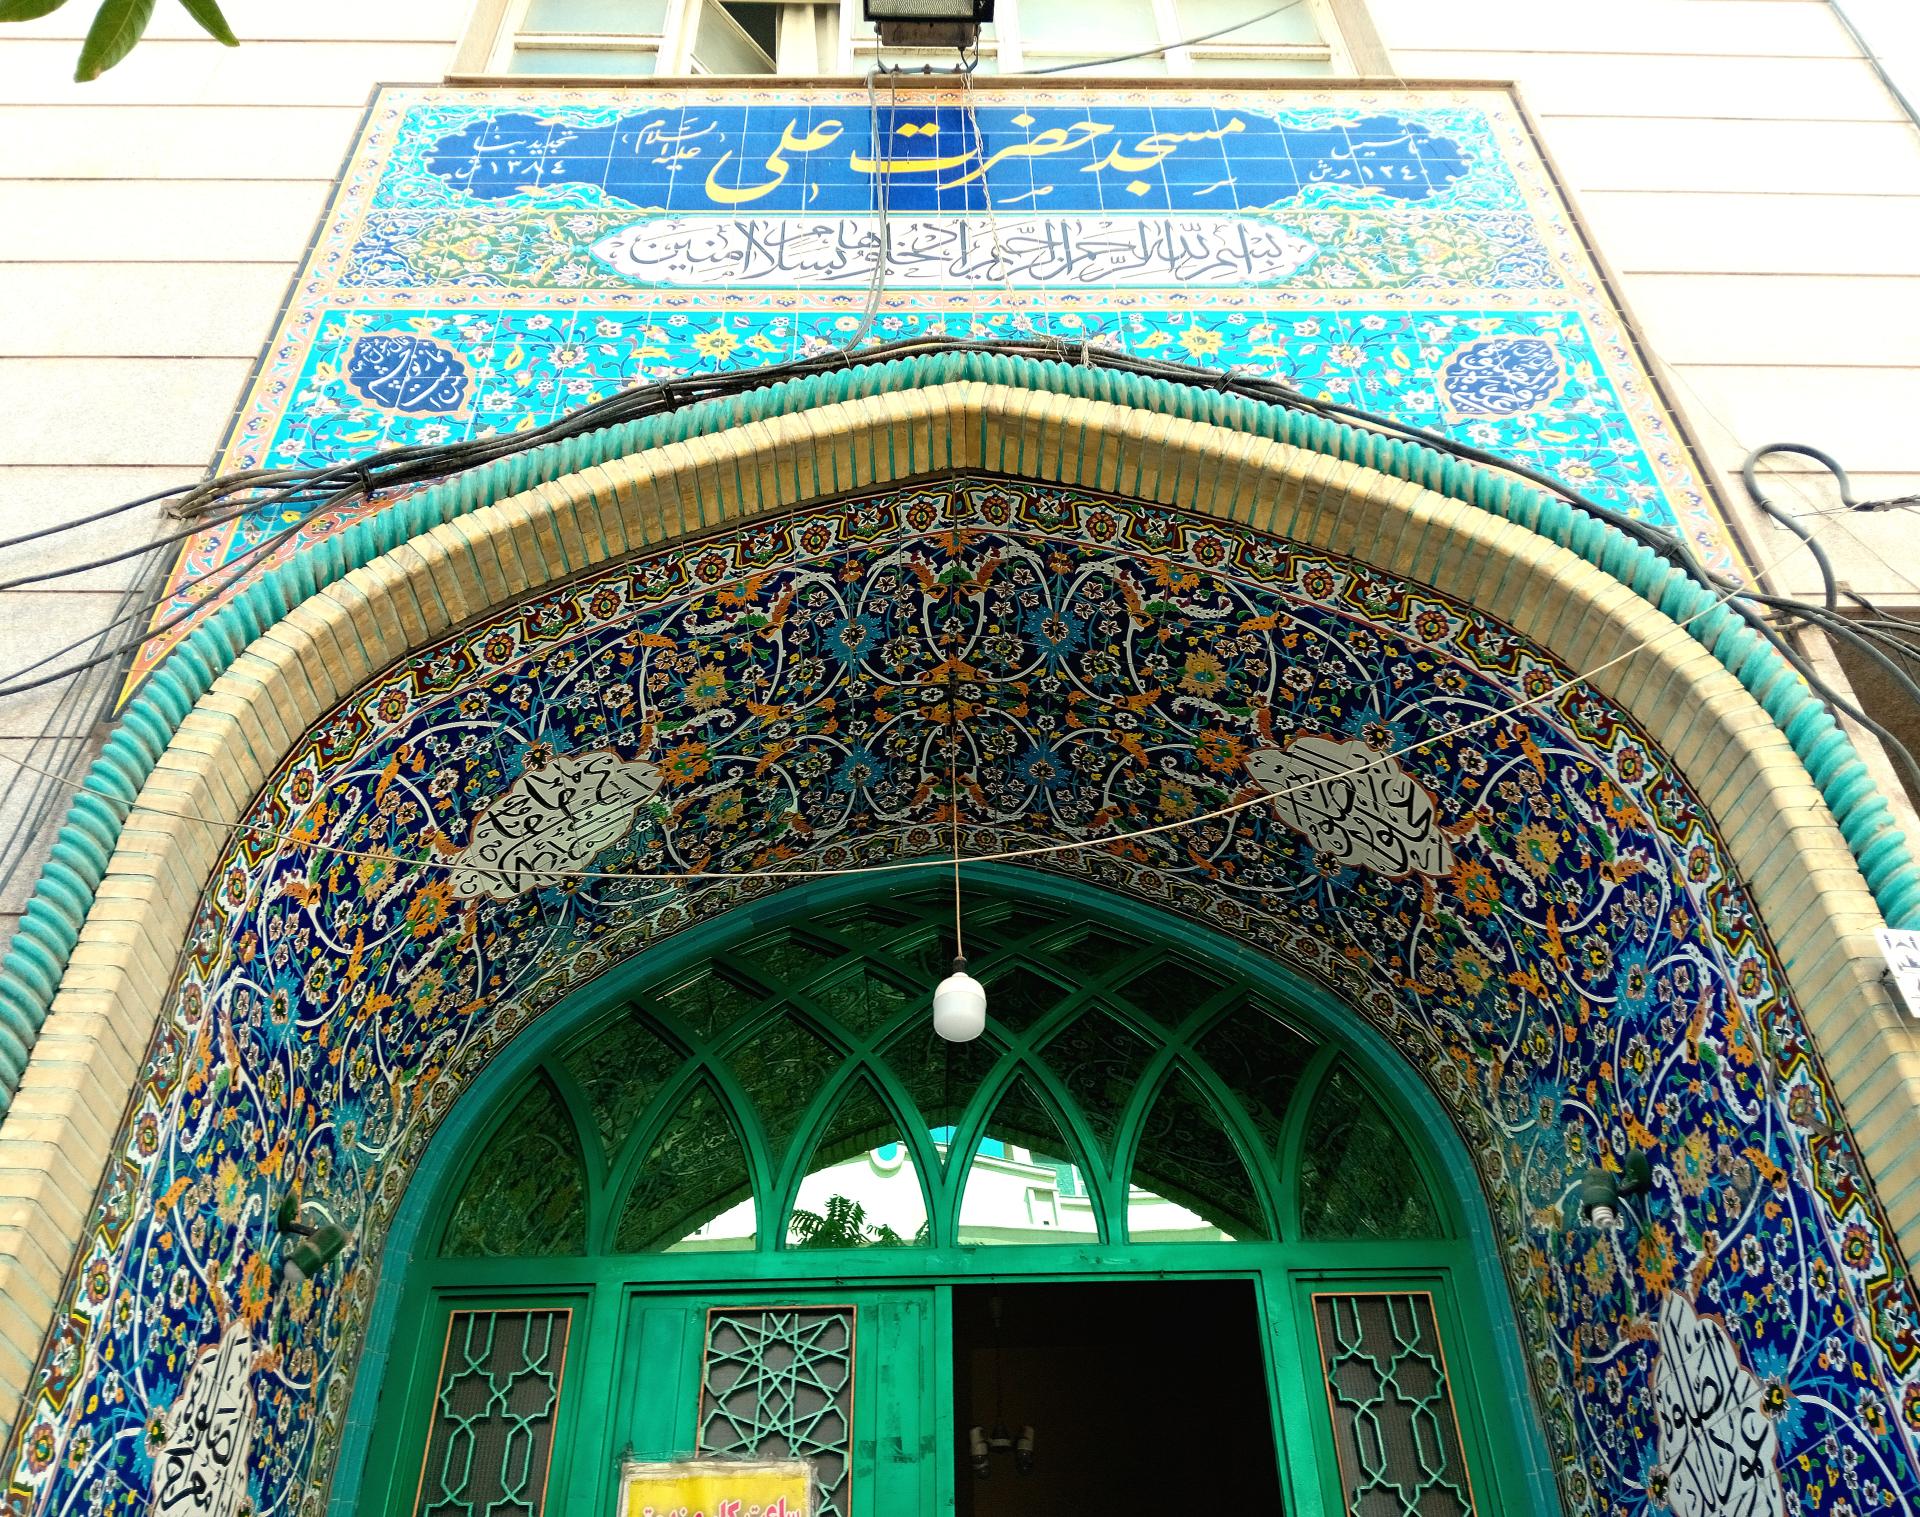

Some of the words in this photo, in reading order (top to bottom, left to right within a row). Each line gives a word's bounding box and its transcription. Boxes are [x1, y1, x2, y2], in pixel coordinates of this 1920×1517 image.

[705, 118, 844, 204] علی
[850, 113, 1115, 190] حضرت
[1080, 117, 1246, 197] مسجد
